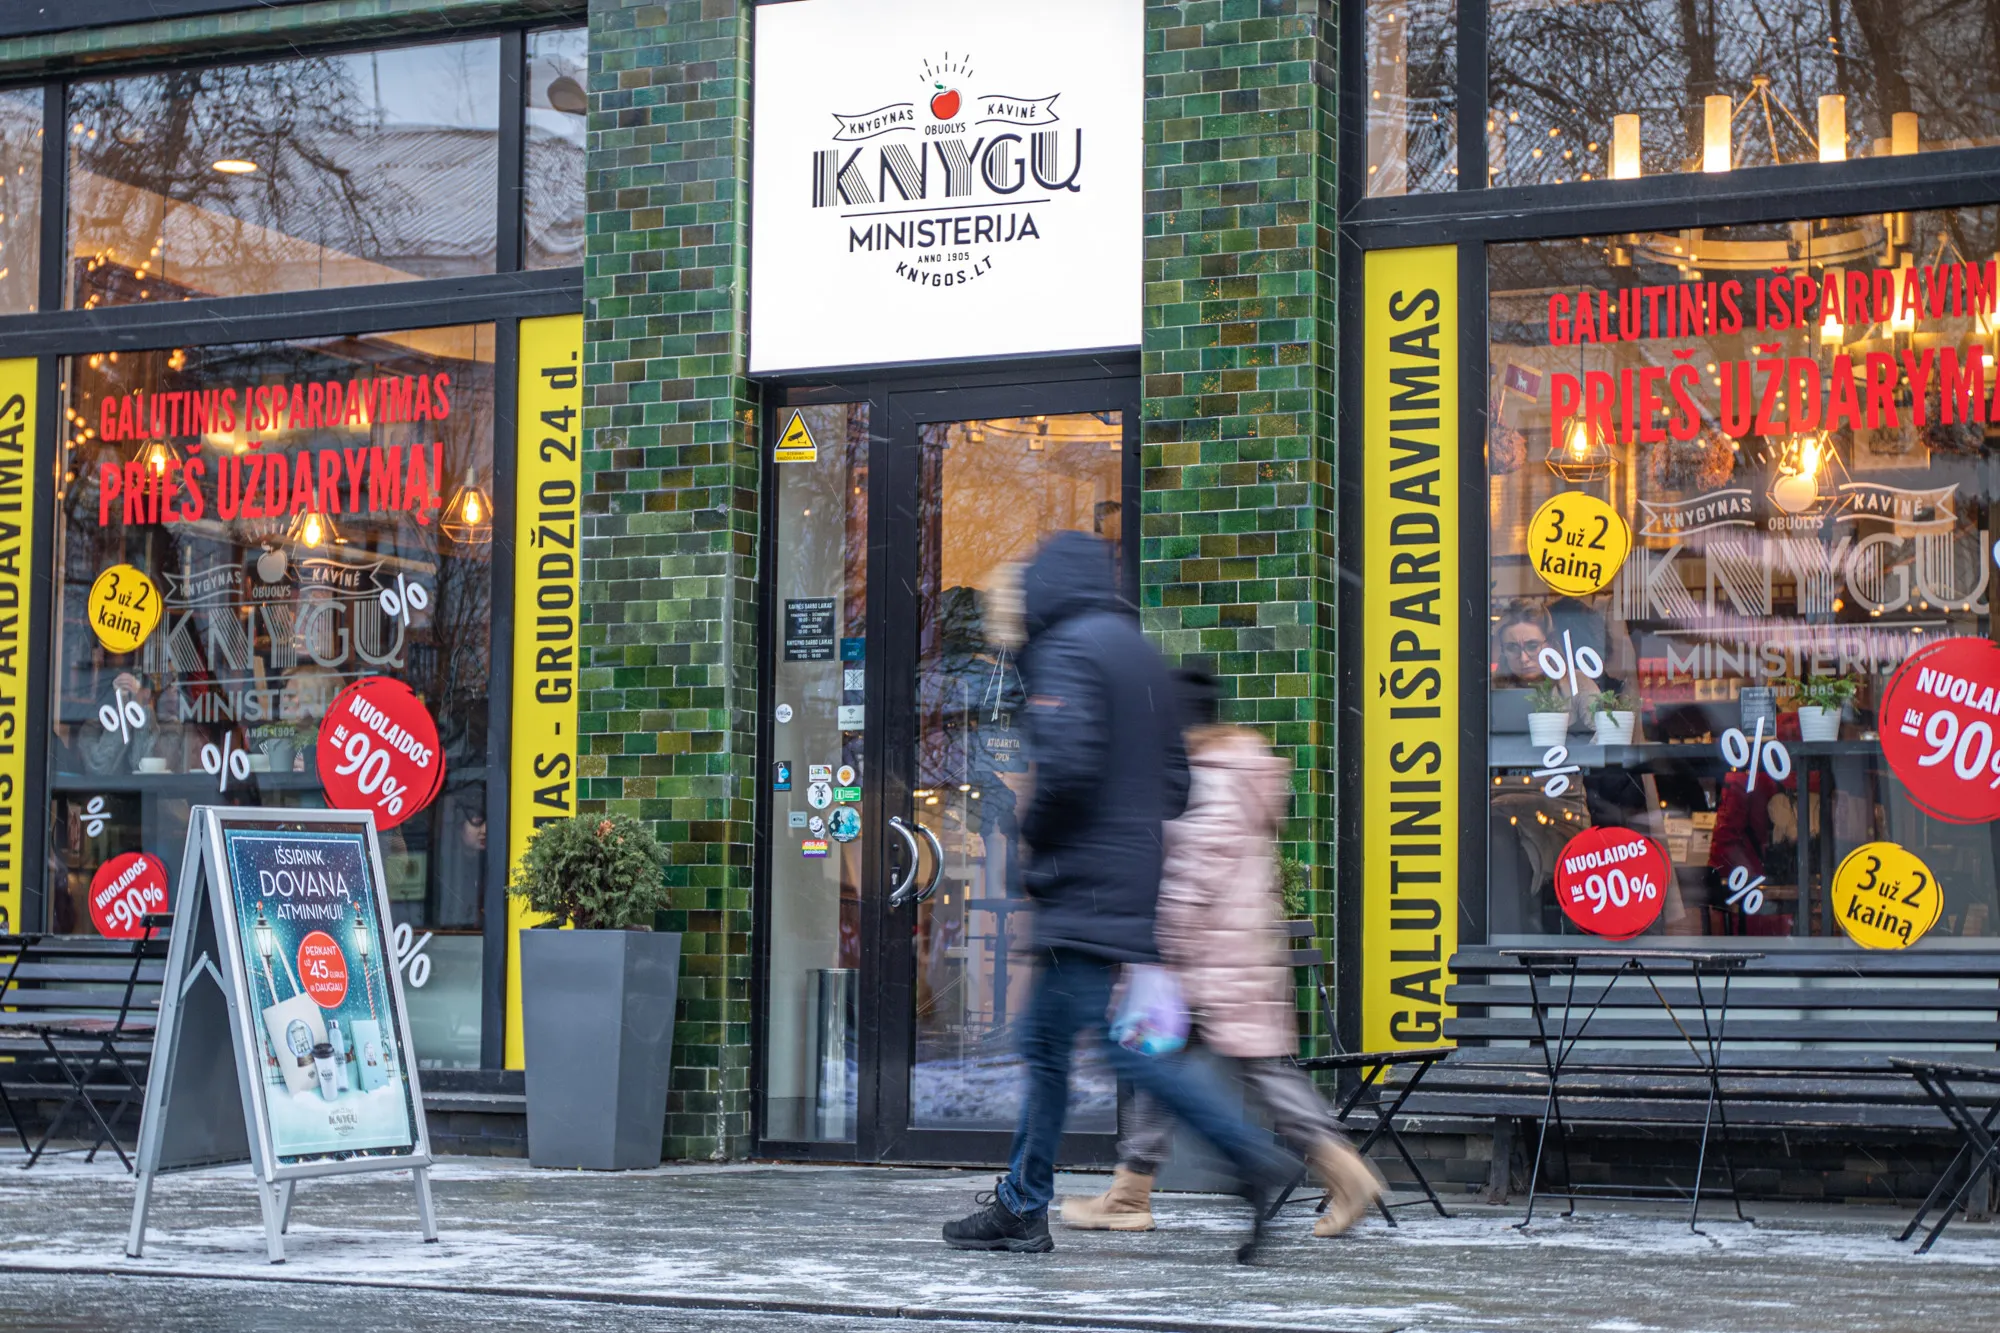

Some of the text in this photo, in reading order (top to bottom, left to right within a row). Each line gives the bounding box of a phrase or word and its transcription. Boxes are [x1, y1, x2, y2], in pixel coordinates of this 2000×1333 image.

[850, 109, 914, 134] KNYGYNAS
[925, 122, 966, 135] OBUOLYS
[987, 103, 1037, 118] KAVINĖ
[849, 212, 1040, 252] MINISTERIJA
[896, 255, 993, 287] KNYGOS.LT
[917, 252, 970, 263] ANNO 1905
[1549, 280, 1743, 347] GALUTINIS
[541, 351, 577, 390] d.
[100, 387, 237, 442] GALUTINIS
[1551, 343, 2000, 448] PRIEŠ UŽDARYM
[539, 405, 577, 463] 24
[99, 441, 444, 527] PRIEŠ UŽDARYMĄ!
[1663, 497, 1752, 528] KNYGYNAS
[1768, 515, 1824, 531] OBUOLYS
[1854, 492, 1923, 516] KAVINĖ
[1545, 509, 1609, 550] 3 už 2
[179, 571, 242, 596] KNYGYNAS
[312, 568, 361, 586] KAVINĖ
[1540, 548, 1602, 587] kainą
[104, 573, 150, 612] 3 už 2
[252, 585, 291, 599] OBUOLYS
[530, 480, 576, 704] GRUODŽIO
[98, 605, 141, 642] kainą
[1378, 288, 1442, 1044] GALUTINIS IŠPARDAVIMAS
[1667, 634, 1918, 681] MINISTERIJ
[348, 694, 433, 768] NUOLAIDOS
[1903, 708, 2000, 789] iki 90
[334, 732, 408, 816] 90%
[995, 752, 1010, 762] OPEN
[274, 845, 325, 865] IŠSIRINK
[1565, 839, 1648, 875] NUOLAIDOS
[95, 857, 147, 910] NUOLAIDOS
[259, 869, 352, 904] DOVANĄ
[1585, 868, 1657, 914] 90%
[1856, 855, 1927, 909] 3 už 2
[113, 881, 163, 932] 90%
[277, 903, 344, 920] ATMINIMUI!
[1846, 894, 1913, 946] kainą
[305, 946, 337, 956] PERKANT
[310, 960, 329, 979] 45
